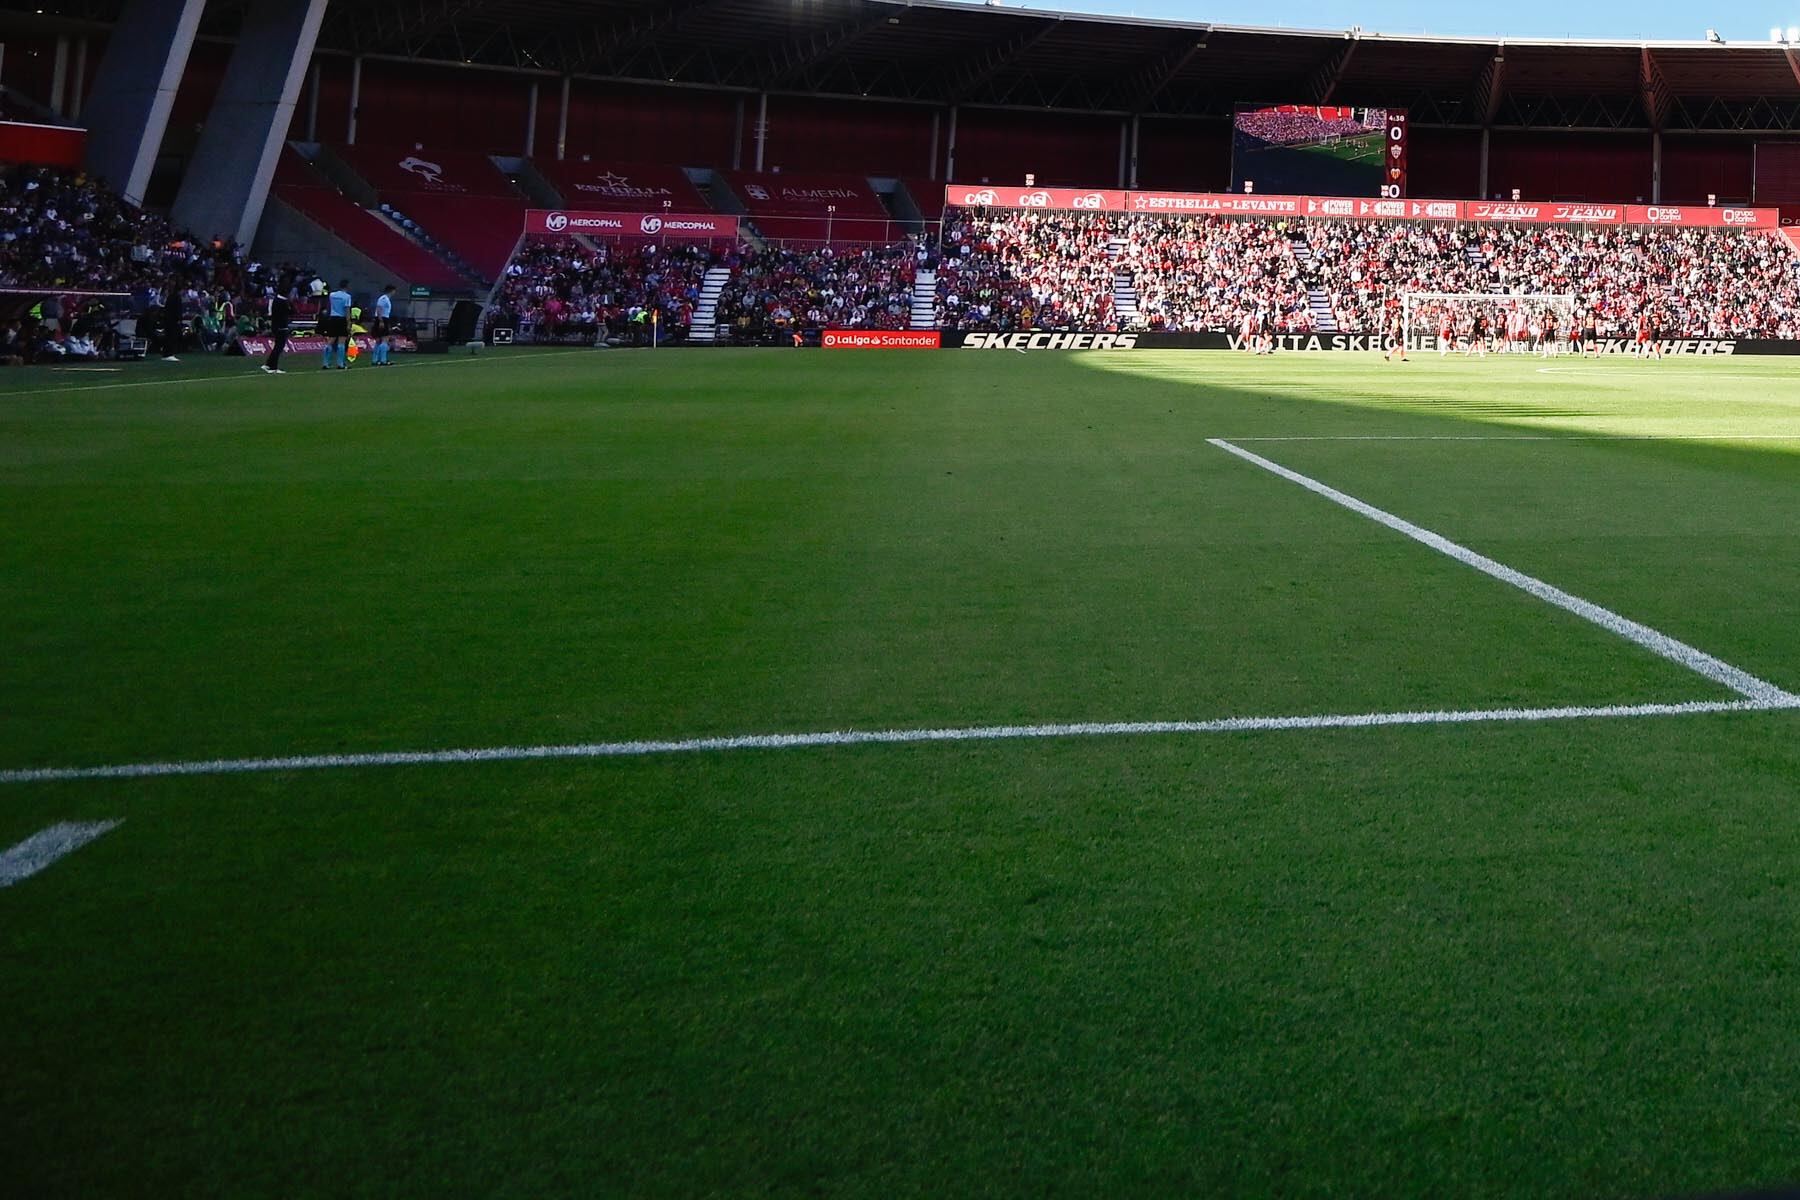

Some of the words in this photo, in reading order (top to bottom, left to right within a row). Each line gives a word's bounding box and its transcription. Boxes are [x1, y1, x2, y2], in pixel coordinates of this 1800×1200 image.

[1390, 126, 1402, 141] 0
[782, 188, 859, 199] ALMERÍA
[1388, 184, 1400, 198] 0
[663, 200, 672, 208] 52
[1148, 197, 1221, 209] ESTRELLA
[1232, 200, 1296, 211] LEVANTE
[1329, 200, 1353, 208] POWER
[1381, 202, 1405, 210] POWER
[1432, 203, 1456, 211] POWER
[1329, 207, 1353, 215] HORSE
[1381, 209, 1405, 217] HORSE
[1432, 210, 1456, 218] HORSE
[1659, 208, 1679, 216] grupo
[1734, 210, 1754, 218] grupo
[1659, 213, 1682, 221] control
[1734, 215, 1757, 223] control
[569, 218, 623, 229] MERCOPHAL
[664, 220, 716, 231] MERCOPHAL
[837, 336, 871, 347] LaLiga
[881, 335, 937, 347] Santander
[961, 332, 1139, 350] SKECHERS
